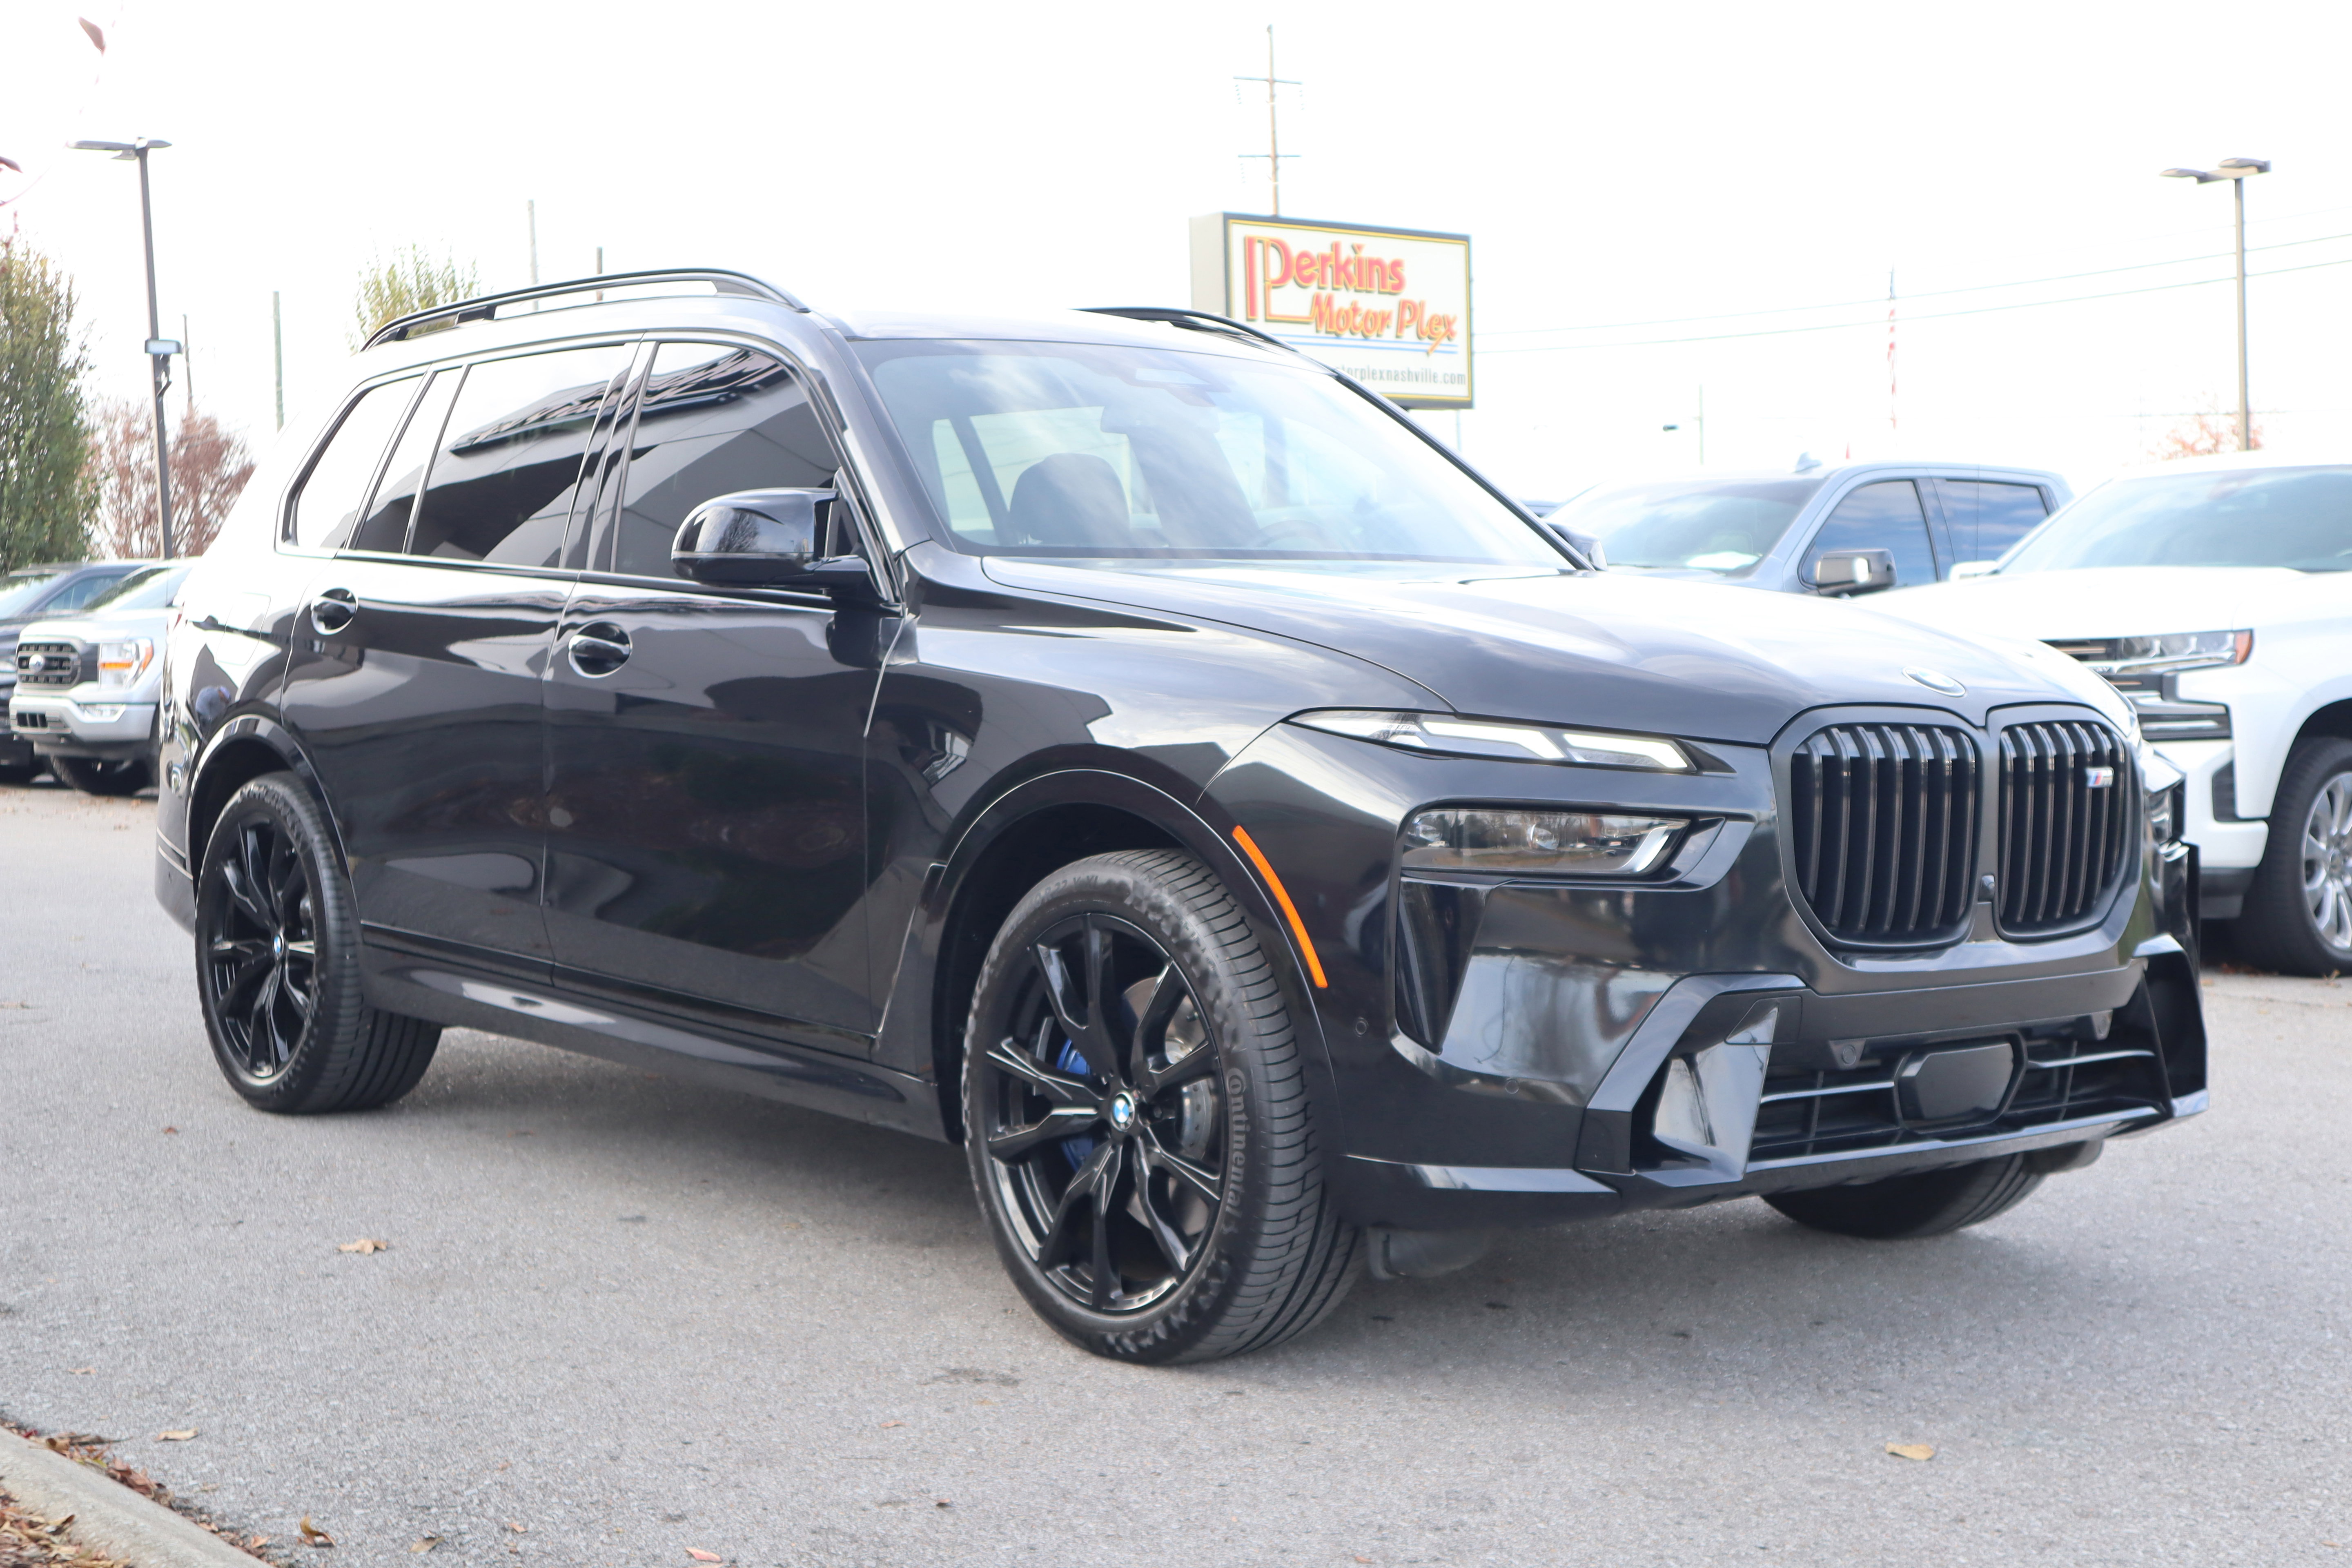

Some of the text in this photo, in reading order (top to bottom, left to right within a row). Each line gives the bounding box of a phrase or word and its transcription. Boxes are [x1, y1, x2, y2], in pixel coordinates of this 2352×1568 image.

[1245, 235, 1406, 321] Perkins
[1312, 292, 1457, 356] Motor Plex
[1226, 1068, 1251, 1218] Continental
